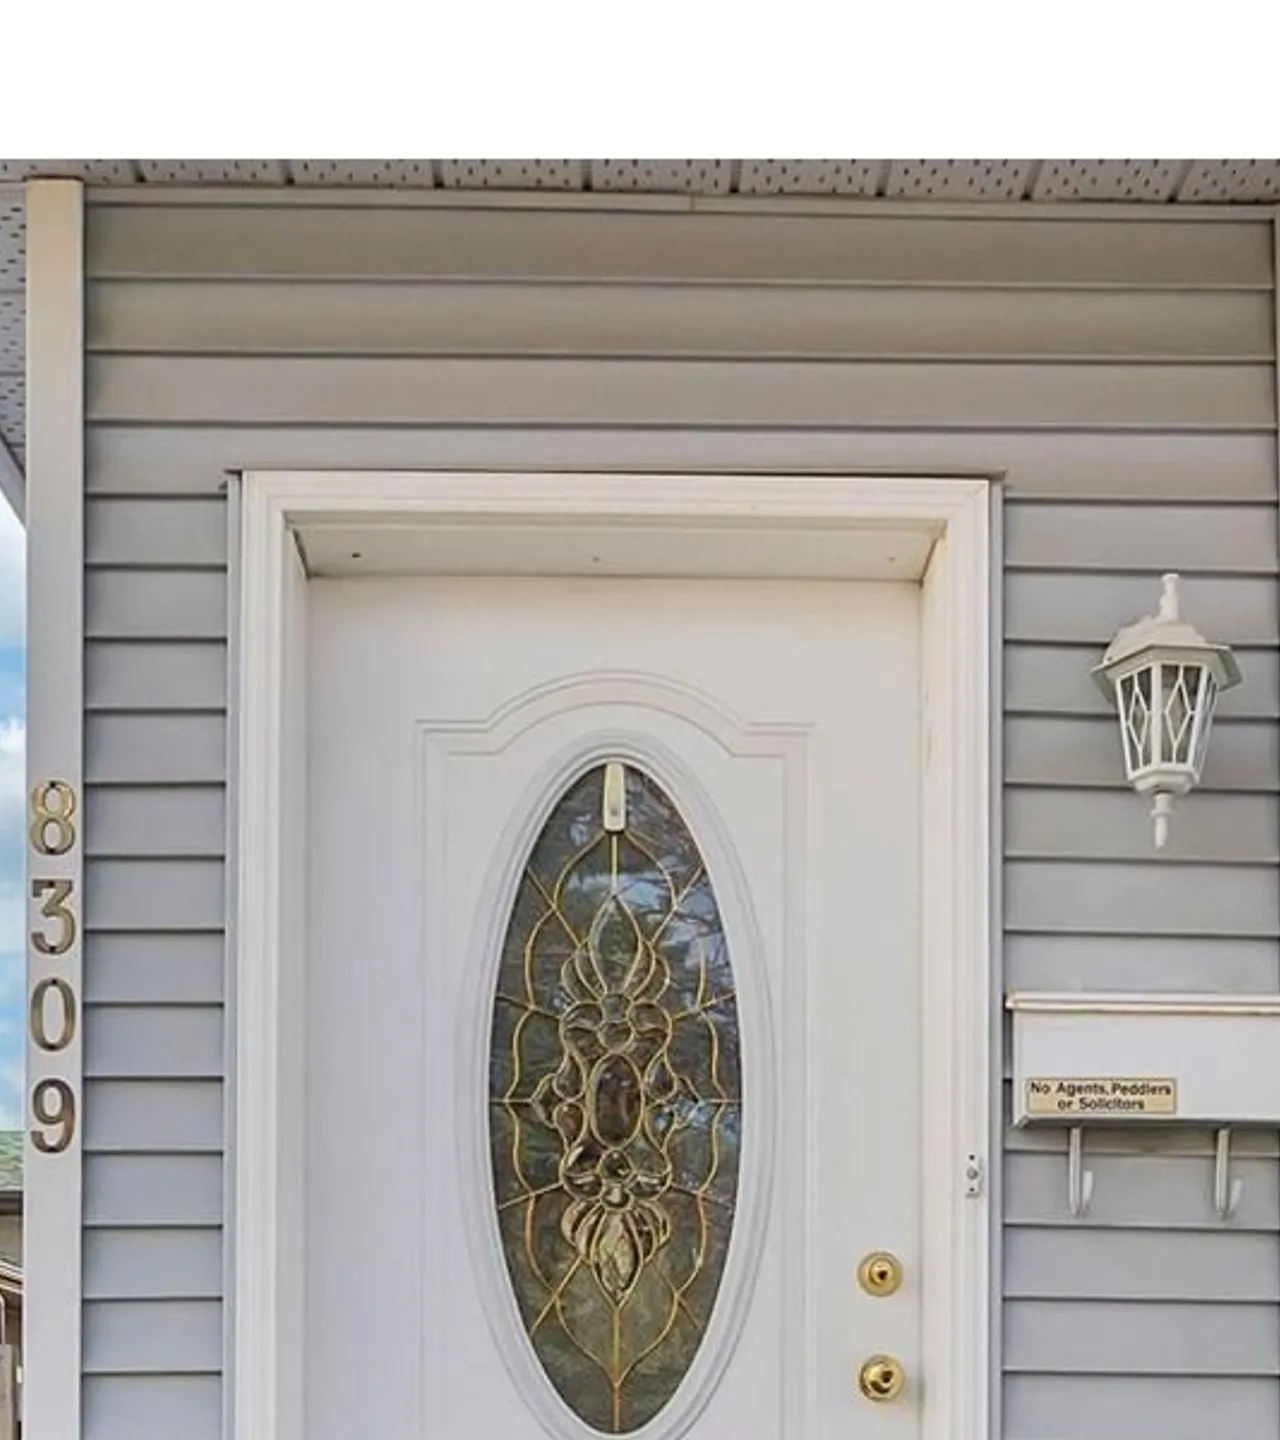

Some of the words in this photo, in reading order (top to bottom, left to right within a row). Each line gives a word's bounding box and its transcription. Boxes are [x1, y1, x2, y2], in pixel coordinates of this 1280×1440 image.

[30, 780, 76, 1154] 8309
[1030, 1081, 1051, 1094] No
[1111, 1082, 1172, 1096] Peddlers
[1057, 1099, 1073, 1110] or
[1079, 1097, 1144, 1110] Solicitors
